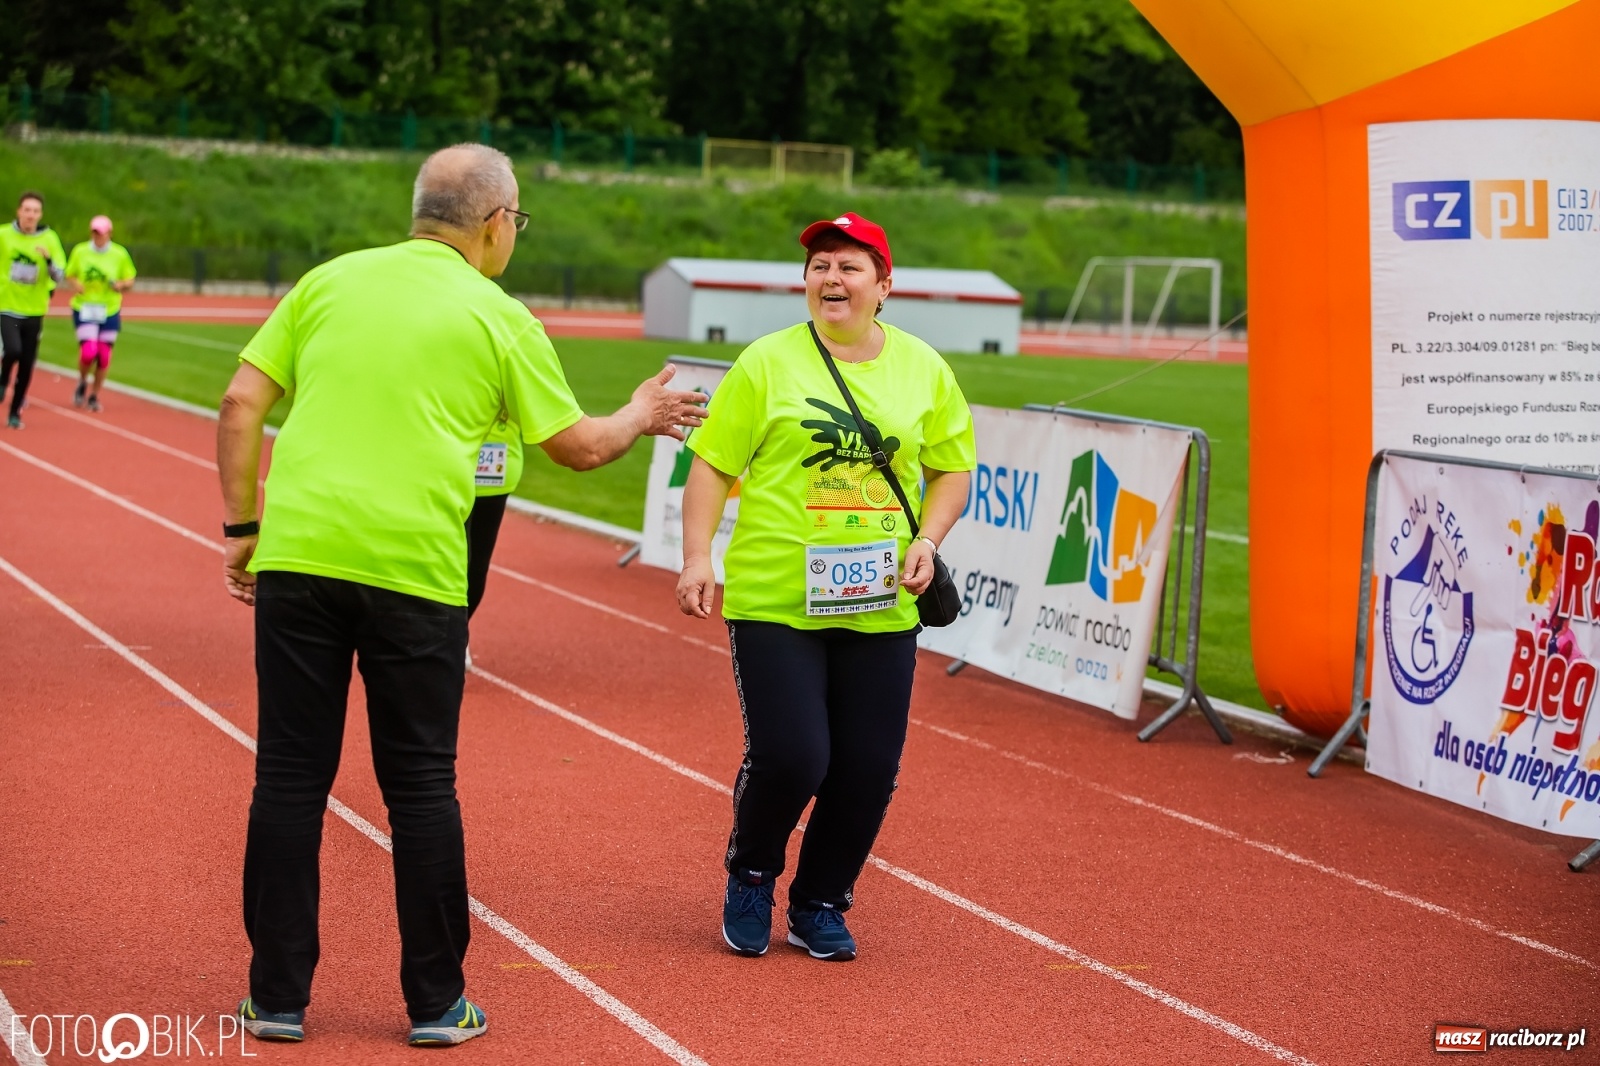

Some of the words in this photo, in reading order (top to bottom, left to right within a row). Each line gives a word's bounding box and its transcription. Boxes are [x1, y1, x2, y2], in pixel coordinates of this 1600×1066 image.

[1579, 188, 1600, 209] 3/
[1427, 311, 1474, 325] Projekt
[1477, 313, 1485, 322] o
[1489, 313, 1541, 322] numerze
[1391, 343, 1412, 353] PL.
[1415, 341, 1536, 353] 3.22/3.304/09.01281
[1400, 373, 1425, 387] jest
[1429, 371, 1544, 386] współfinansowany
[1548, 374, 1557, 382] w
[1560, 371, 1581, 382] 85%
[1584, 373, 1594, 382] ze
[1426, 402, 1519, 416] Europejskiego
[1522, 402, 1577, 413] Funduszu
[1412, 433, 1501, 448] Regionalnego
[1505, 434, 1531, 444] oraz
[1534, 433, 1549, 443] do
[1553, 432, 1574, 443] 10%
[1577, 434, 1587, 443] ze
[836, 449, 851, 457] BEZ
[1390, 494, 1427, 555] PODAJ
[1436, 500, 1468, 570] RĘKĘ
[884, 551, 893, 563] R
[831, 560, 878, 585] 085
[1442, 617, 1472, 686] INTEGRACJI
[1500, 626, 1597, 756] Bieg
[1434, 720, 1460, 763] dla
